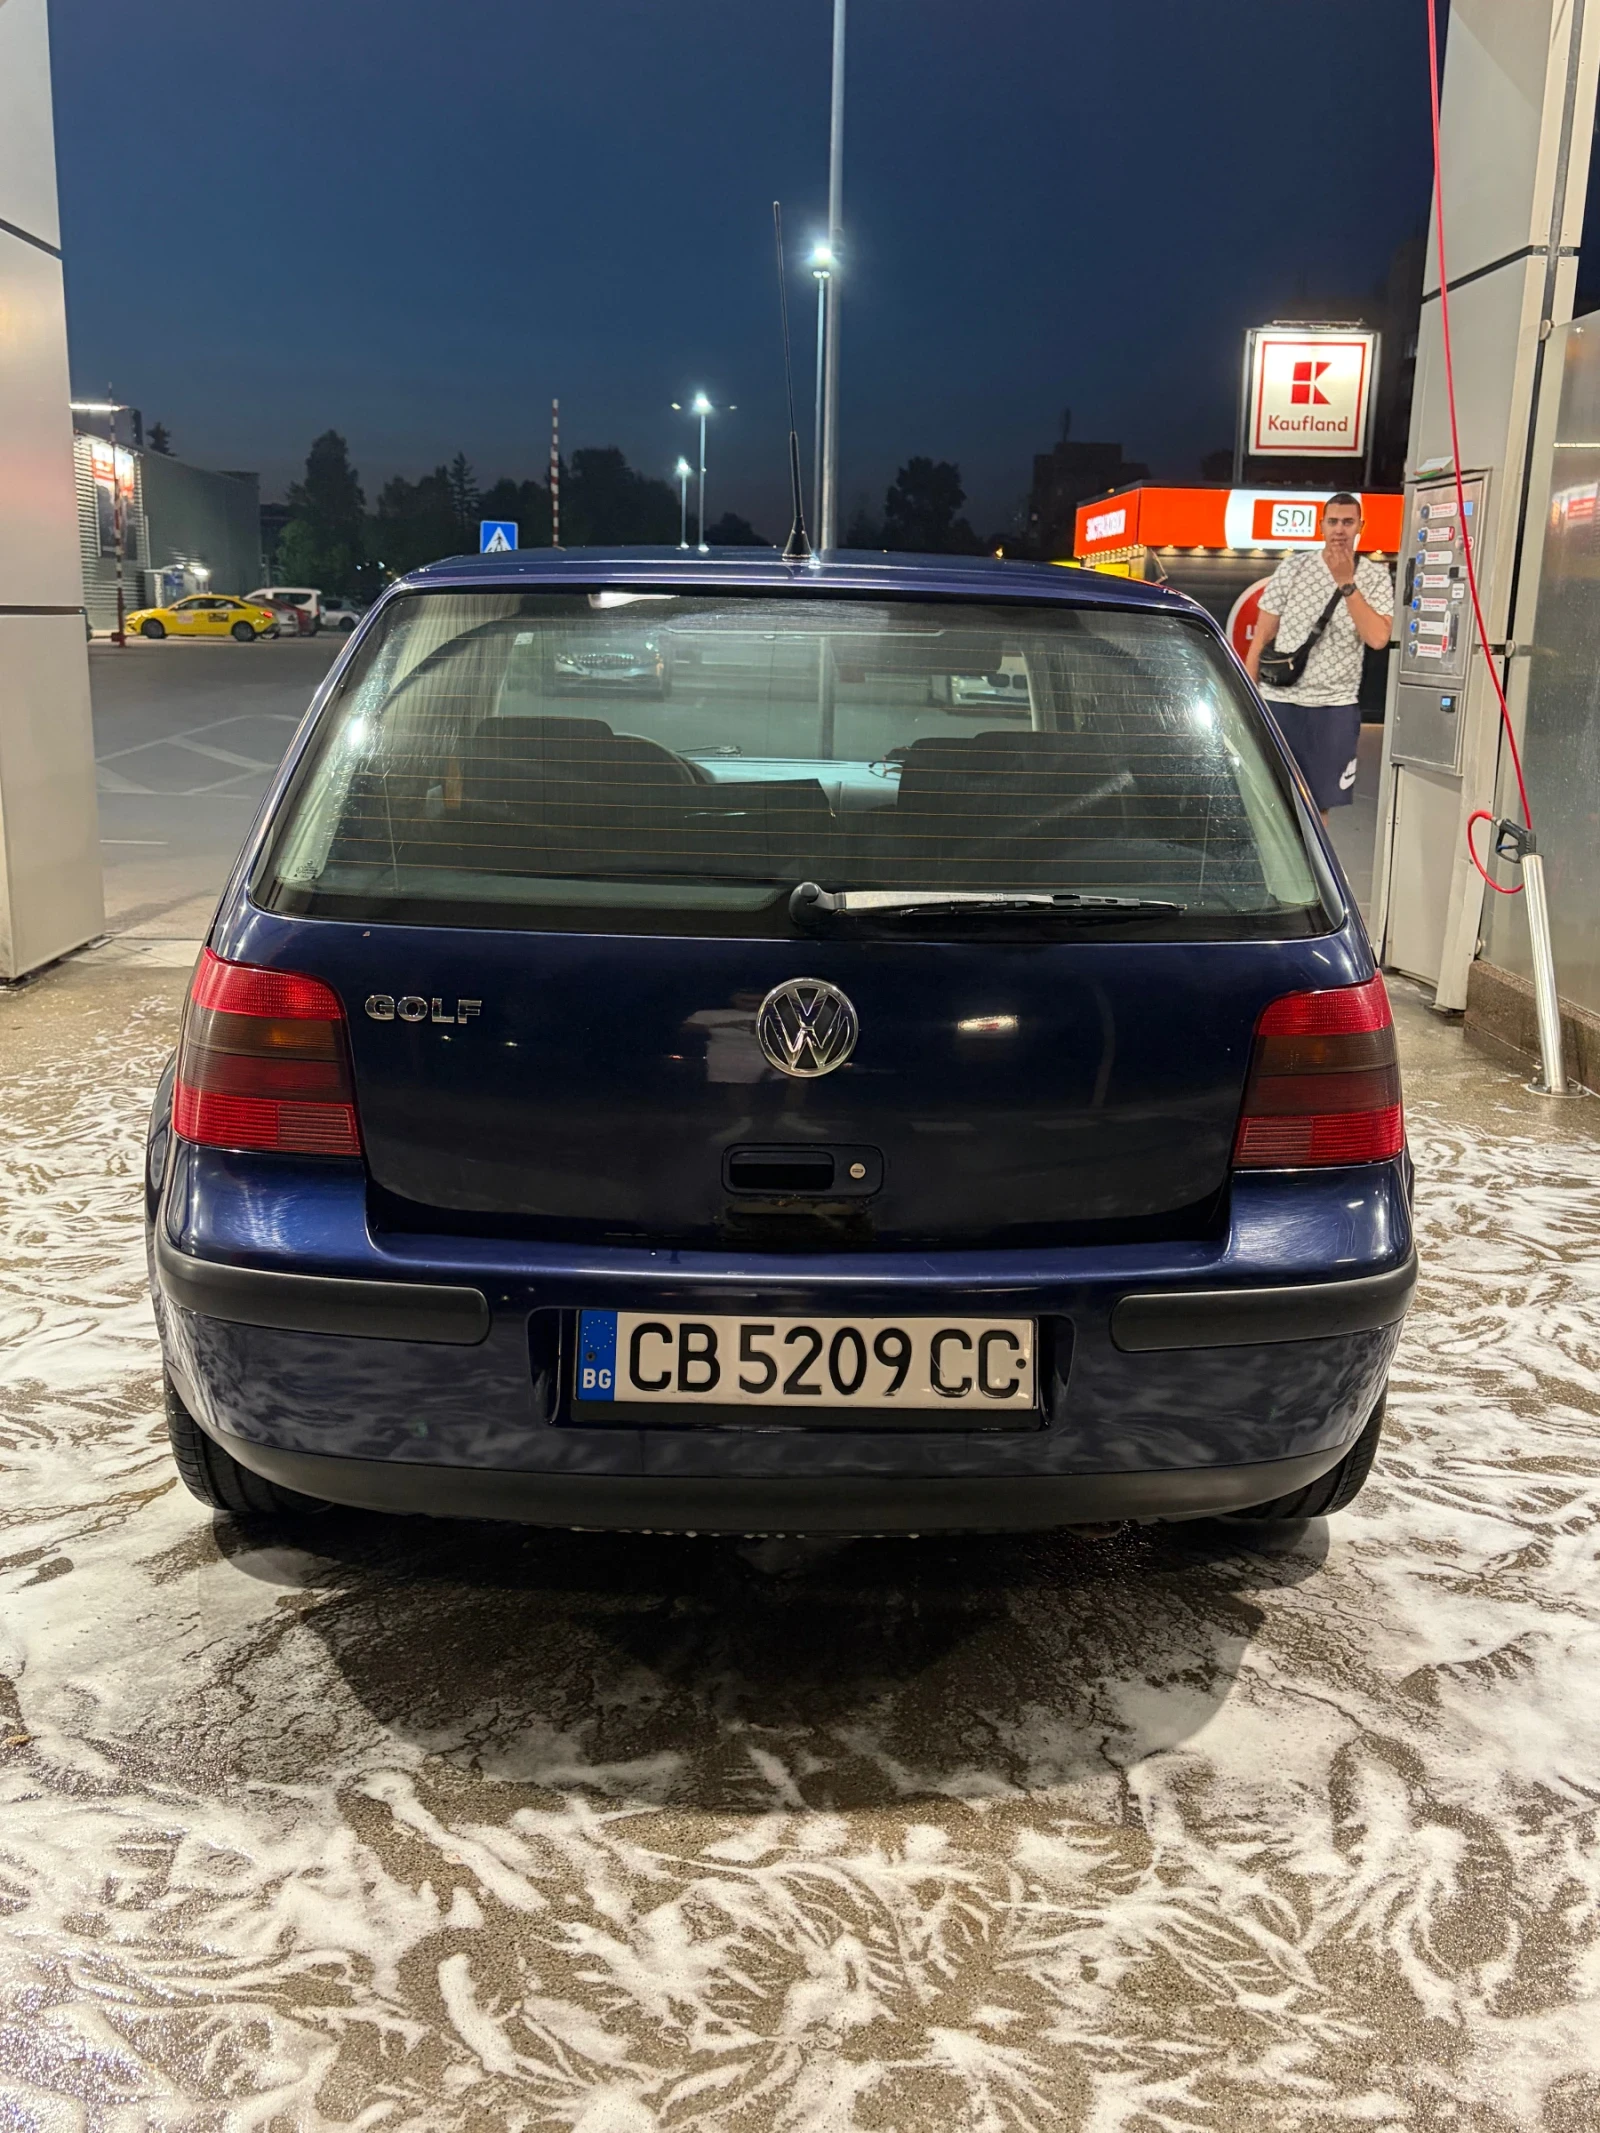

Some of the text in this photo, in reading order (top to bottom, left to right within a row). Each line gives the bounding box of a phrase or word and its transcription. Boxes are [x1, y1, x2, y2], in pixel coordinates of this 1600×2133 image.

[1267, 415, 1349, 432] Kaufland
[1275, 509, 1313, 527] SDI
[365, 995, 483, 1024] GOLF
[629, 1322, 1021, 1400] CB 5209 CC
[582, 1368, 612, 1388] BG
